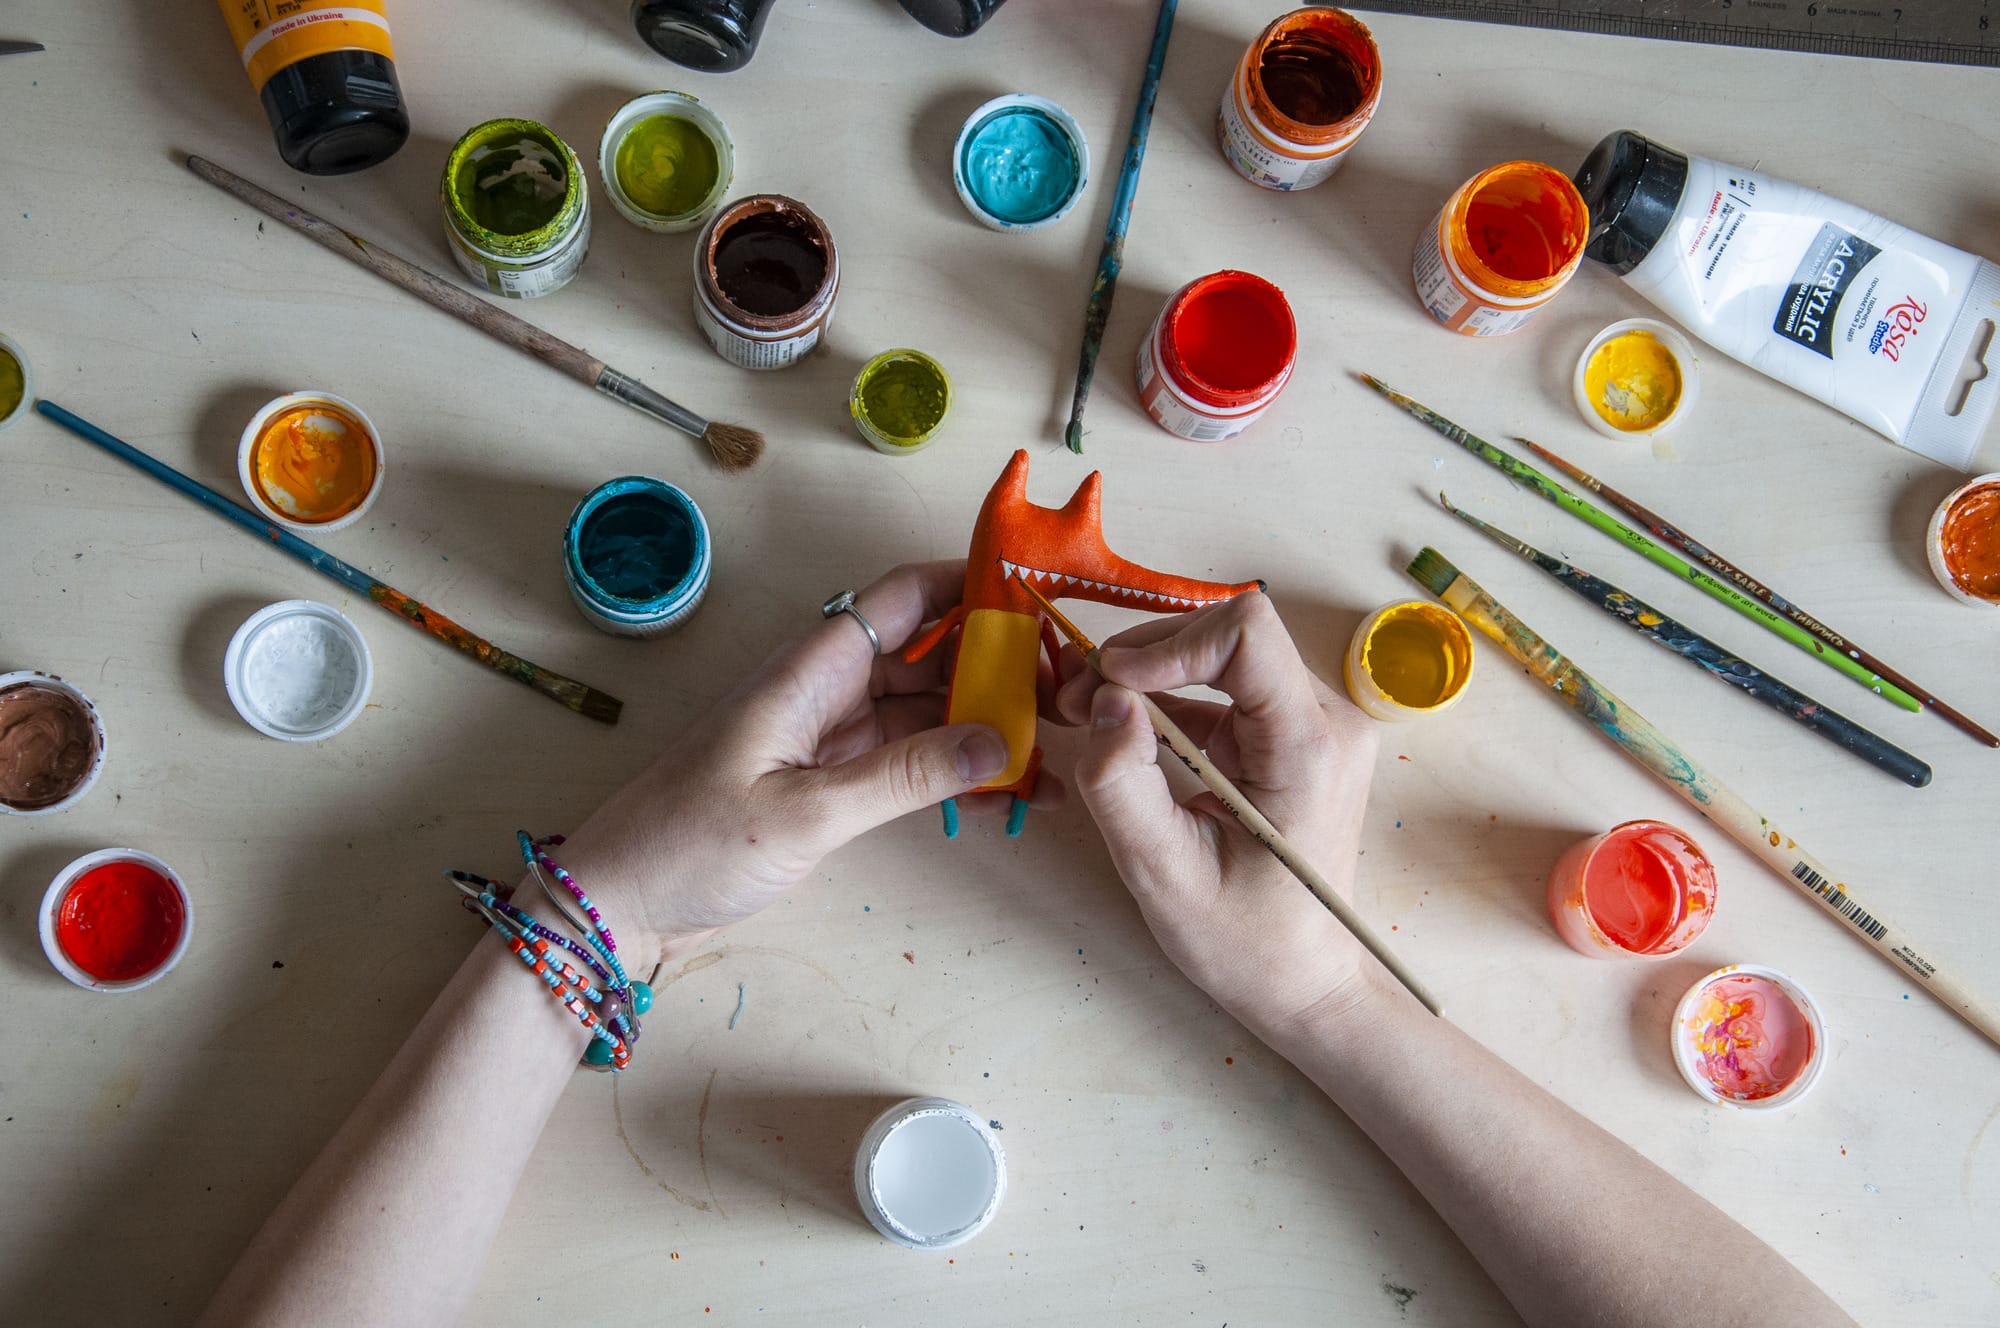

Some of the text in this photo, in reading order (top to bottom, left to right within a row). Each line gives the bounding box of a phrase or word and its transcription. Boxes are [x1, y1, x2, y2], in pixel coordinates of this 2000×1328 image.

[1807, 2, 1818, 17] 6
[1826, 7, 1848, 15] MADE
[1859, 9, 1881, 17] CHINA
[1892, 9, 1903, 24] 7
[271, 12, 344, 37] Made in Ukraine
[1979, 15, 1989, 31] 8
[1747, 181, 1757, 196] 401
[1688, 191, 1723, 257] Made in Ukraine
[1798, 239, 1854, 343] ACRYLIC
[1733, 572, 1768, 597] SABLE
